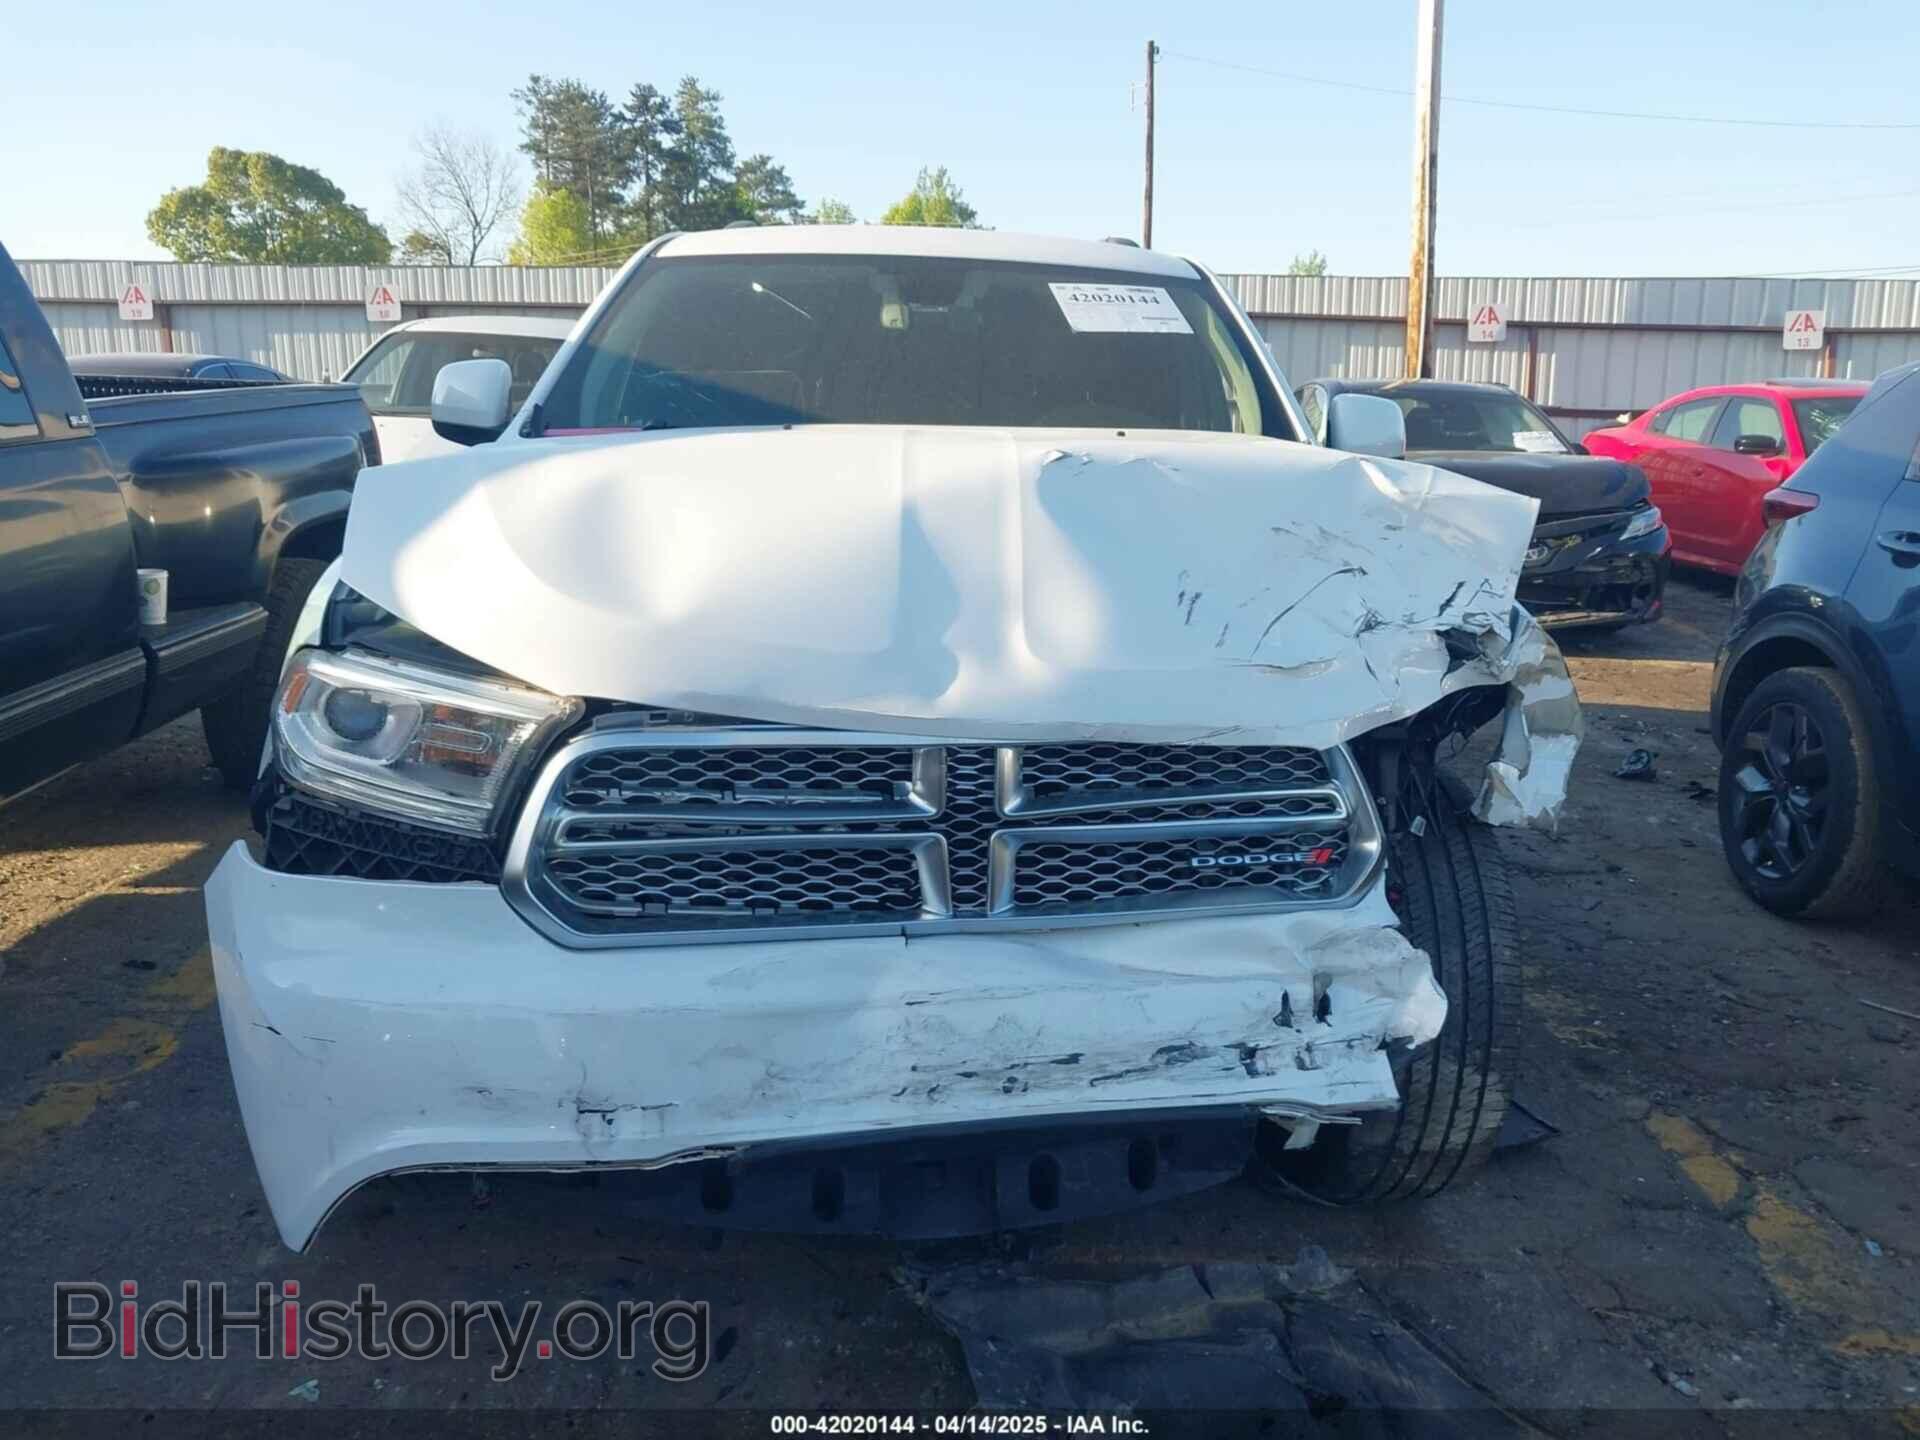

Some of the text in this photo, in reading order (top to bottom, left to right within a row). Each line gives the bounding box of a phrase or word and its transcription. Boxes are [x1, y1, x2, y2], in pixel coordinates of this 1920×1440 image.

[1069, 293, 1161, 305] 42020144
[1482, 330, 1494, 339] 14
[1191, 852, 1317, 867] DODGE
